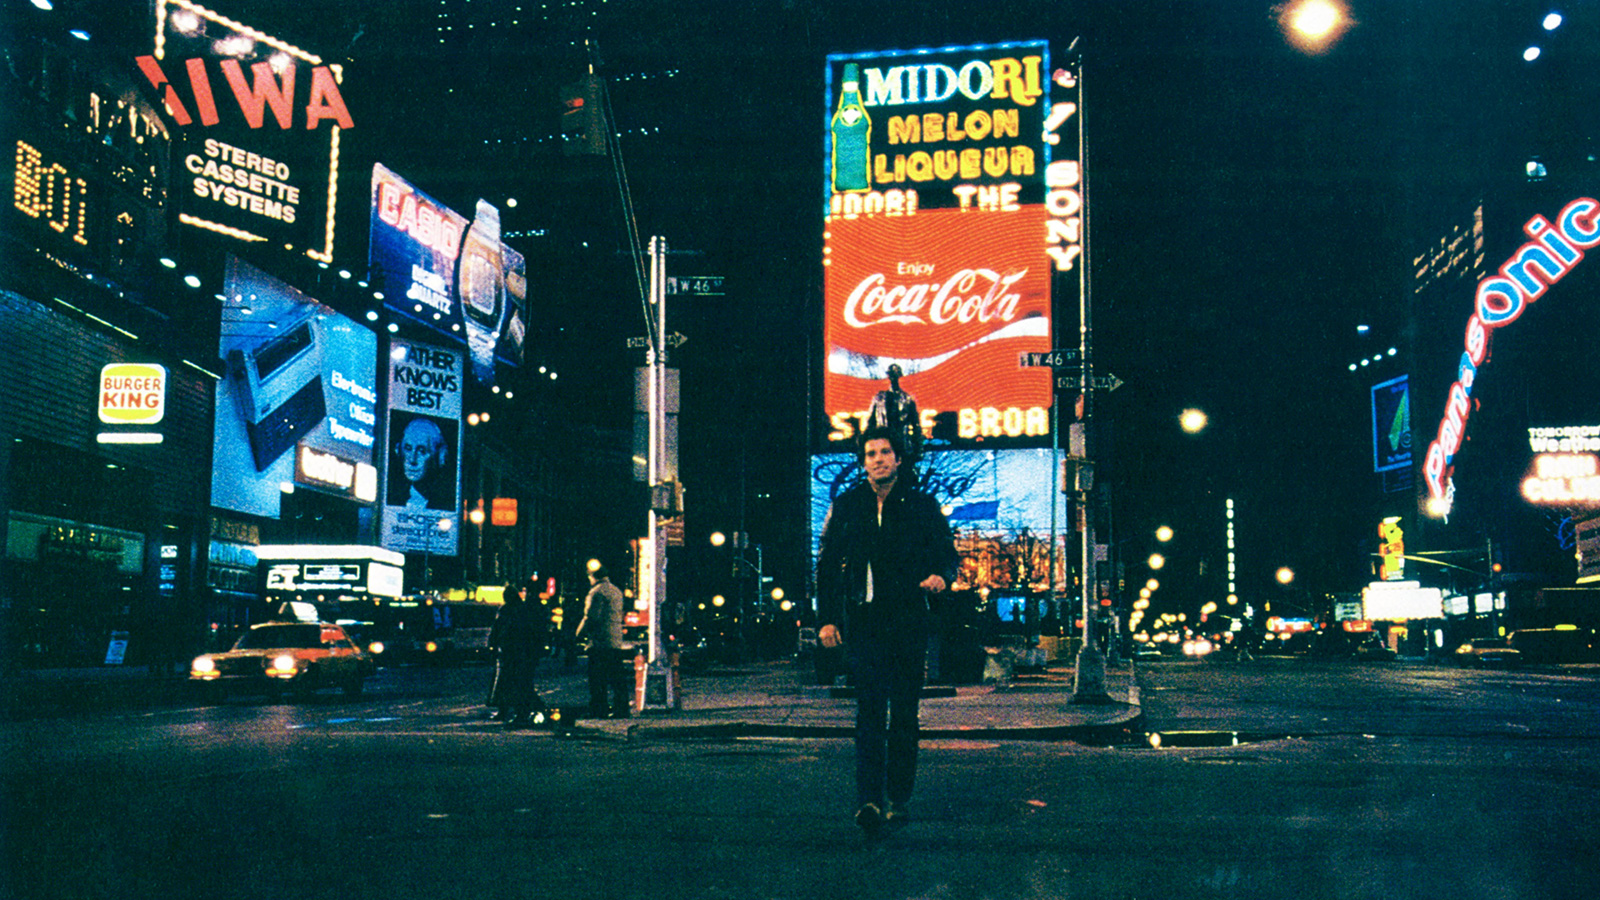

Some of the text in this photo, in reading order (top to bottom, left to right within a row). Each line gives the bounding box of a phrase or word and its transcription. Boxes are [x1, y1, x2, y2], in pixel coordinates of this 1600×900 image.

[864, 55, 1043, 106] MIDORI
[888, 108, 1019, 145] MELON
[204, 138, 290, 181] STEREO
[874, 145, 1035, 183] LIQUEUR
[185, 154, 300, 205] CASSETTE
[193, 177, 296, 223] SYSTEMS
[952, 182, 1022, 213] THE
[378, 181, 461, 262] CASIO
[1045, 160, 1081, 271] SONY
[897, 261, 936, 275] Enjoy
[680, 280, 690, 292] W
[693, 280, 710, 292] 46
[843, 266, 1029, 328] Coca-Cola
[406, 344, 456, 371] ATHER
[1031, 353, 1041, 366] W
[1045, 353, 1063, 366] 46
[103, 377, 162, 391] BURGER
[394, 364, 458, 392] KNOWS
[102, 392, 160, 409] KING
[407, 387, 443, 410] BEST
[957, 406, 1050, 438] BROA
